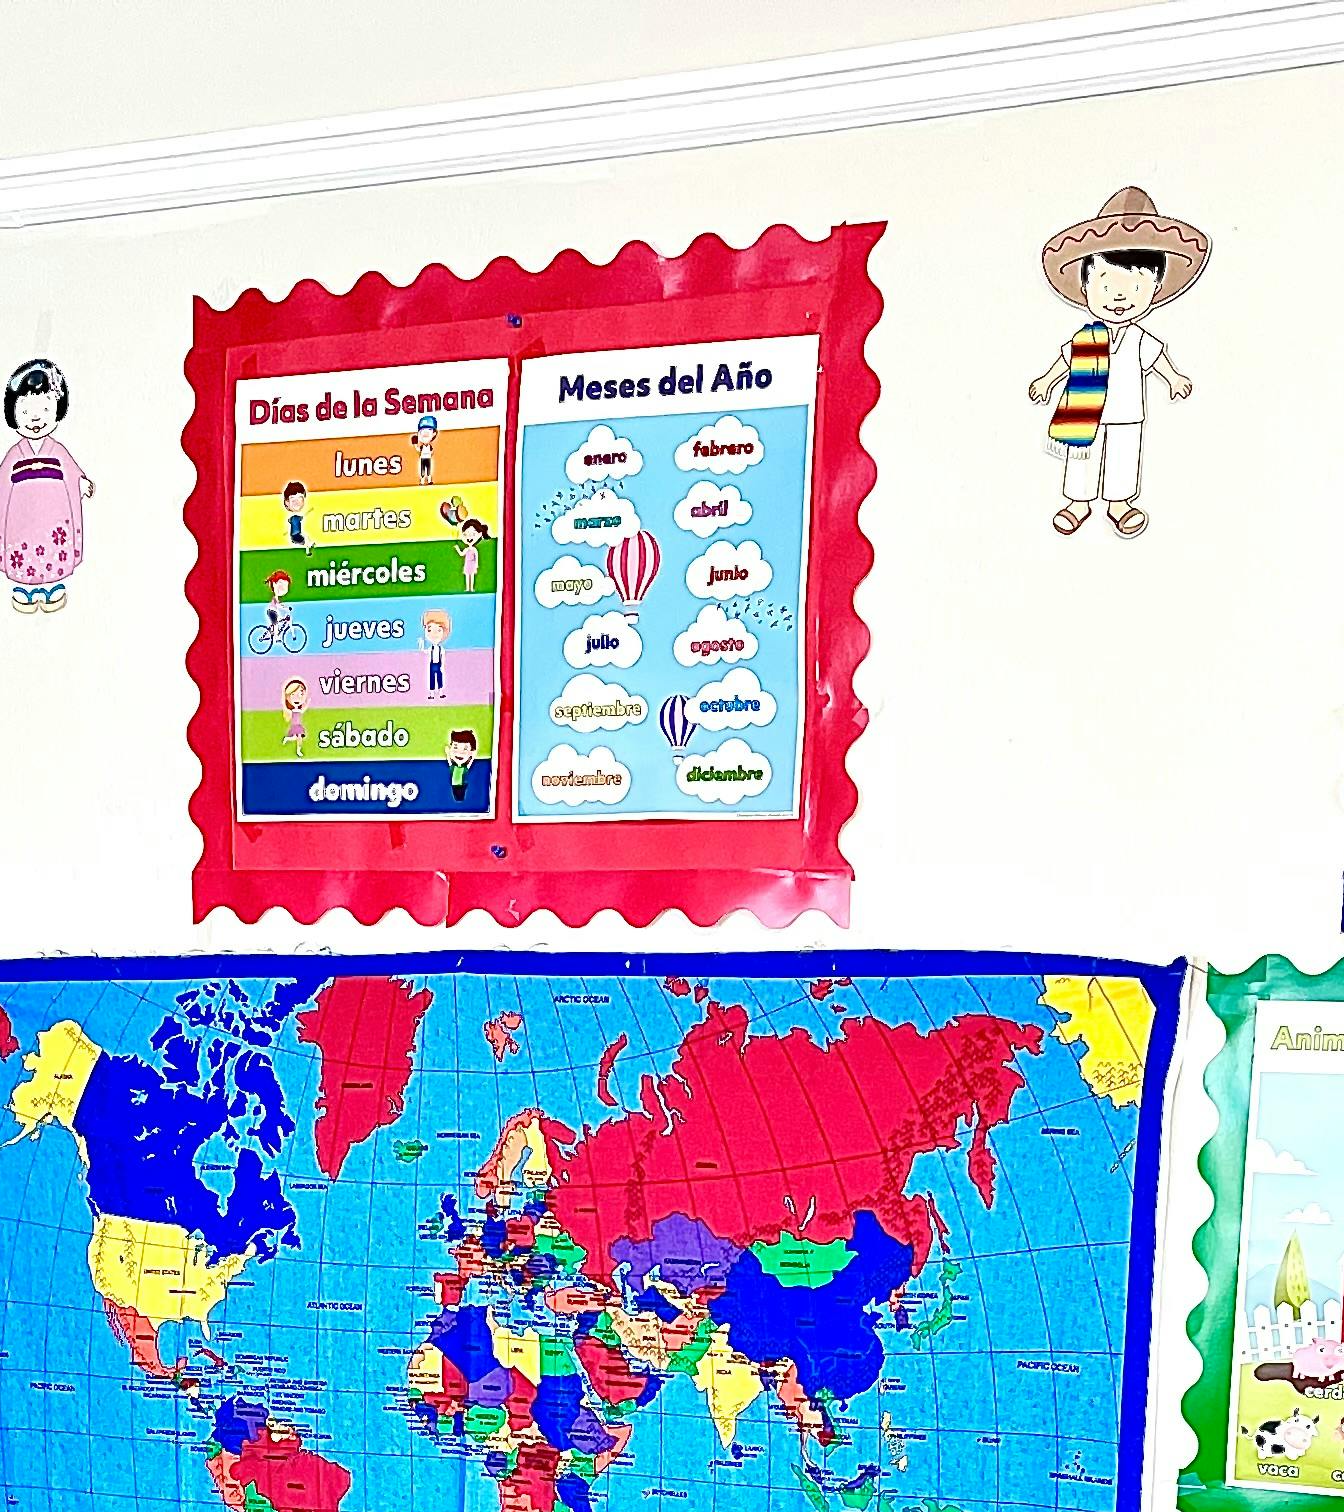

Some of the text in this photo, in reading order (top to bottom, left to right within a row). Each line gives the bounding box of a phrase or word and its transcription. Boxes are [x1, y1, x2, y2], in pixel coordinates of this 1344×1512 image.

[558, 361, 773, 403] Meses del Año
[249, 388, 494, 425] Días de la Semana
[583, 451, 627, 467] enero
[692, 440, 754, 458] febrero
[334, 450, 403, 478] lunes
[690, 500, 729, 518] abril
[322, 507, 411, 532] martes
[573, 515, 622, 529] marzo
[306, 557, 426, 587] miércoles
[706, 564, 749, 587] junio
[551, 577, 593, 595] mayo
[321, 615, 404, 648] jueves
[585, 633, 620, 654] julio
[690, 636, 745, 656] agosto
[319, 668, 411, 695] viernes
[555, 701, 642, 722] septiembre
[699, 696, 761, 713] octubre
[318, 720, 410, 748] sábado
[541, 771, 622, 787] noviembre
[686, 765, 763, 782] diciembre
[309, 775, 418, 807] domingo
[583, 996, 610, 1004] OCEAN
[307, 1302, 338, 1310] ATLANTIC
[1017, 1361, 1080, 1373] PACIFIC OCEAN
[1257, 1462, 1300, 1478] vaca
